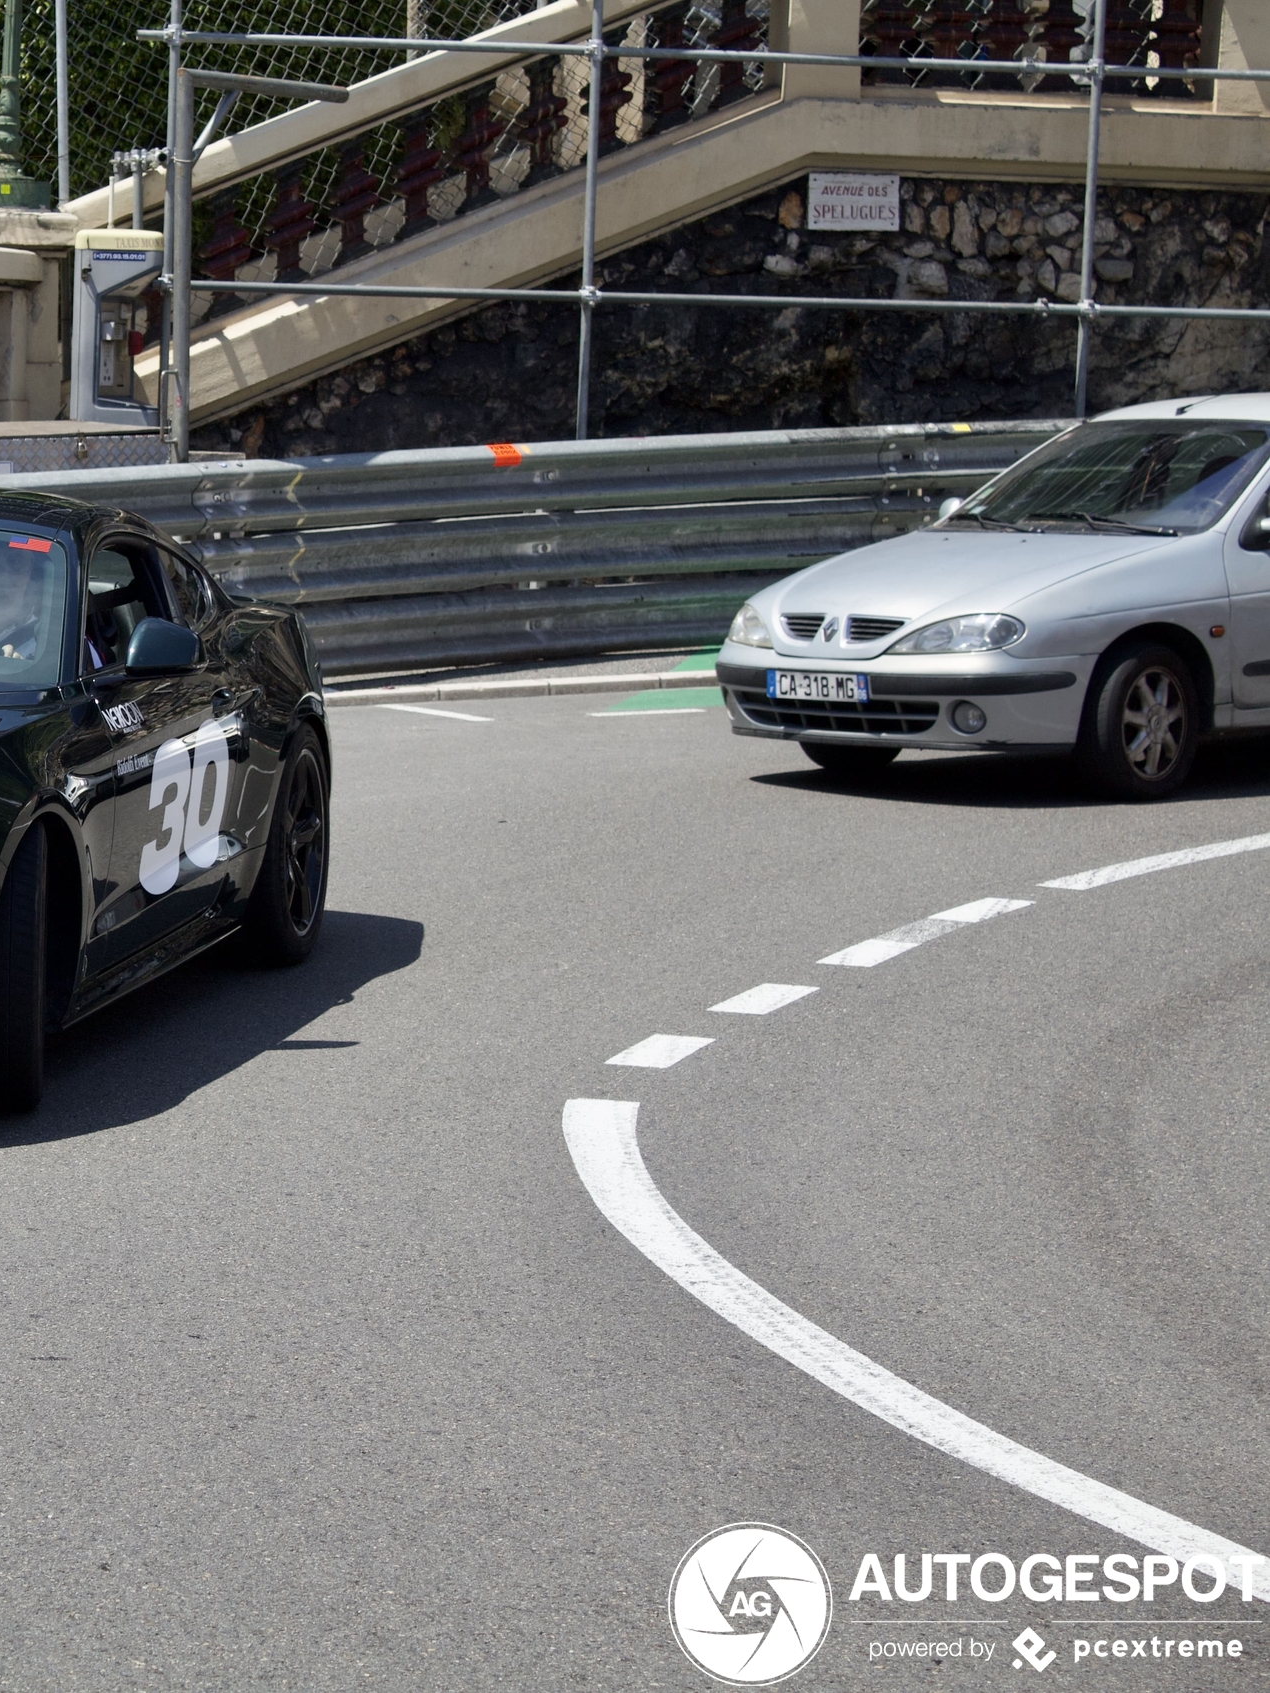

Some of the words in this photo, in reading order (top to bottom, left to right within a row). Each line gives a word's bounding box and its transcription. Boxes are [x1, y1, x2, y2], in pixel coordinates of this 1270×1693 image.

[821, 185, 864, 197] AVENUE
[867, 186, 888, 197] DES
[812, 204, 897, 221] SPELUGUES
[115, 237, 140, 249] TAXIS
[779, 674, 855, 699] CA-318-MG
[138, 718, 230, 896] 30
